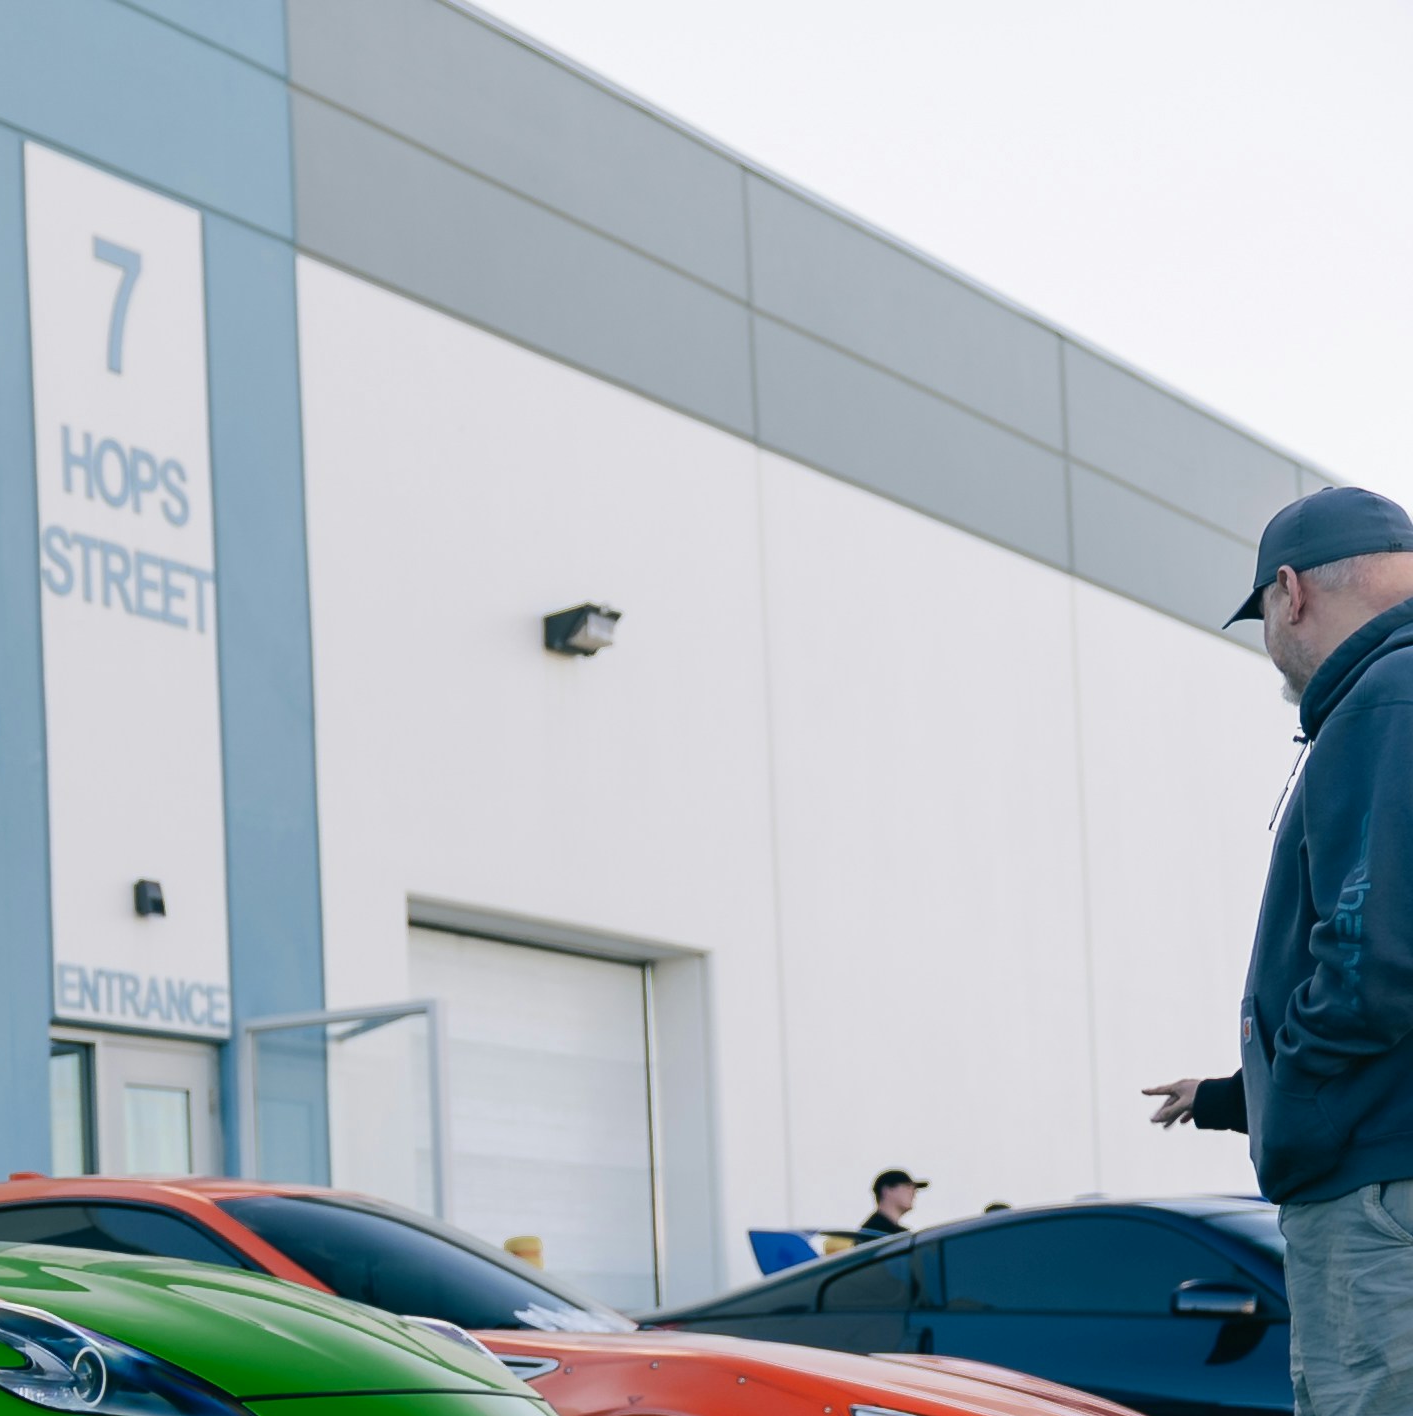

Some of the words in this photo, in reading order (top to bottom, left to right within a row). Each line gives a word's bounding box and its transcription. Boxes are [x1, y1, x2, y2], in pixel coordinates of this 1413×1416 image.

[92, 235, 142, 374] 7
[60, 424, 190, 528] HOPS
[41, 525, 215, 633] STREET
[57, 963, 227, 1028] ENTRANCE
